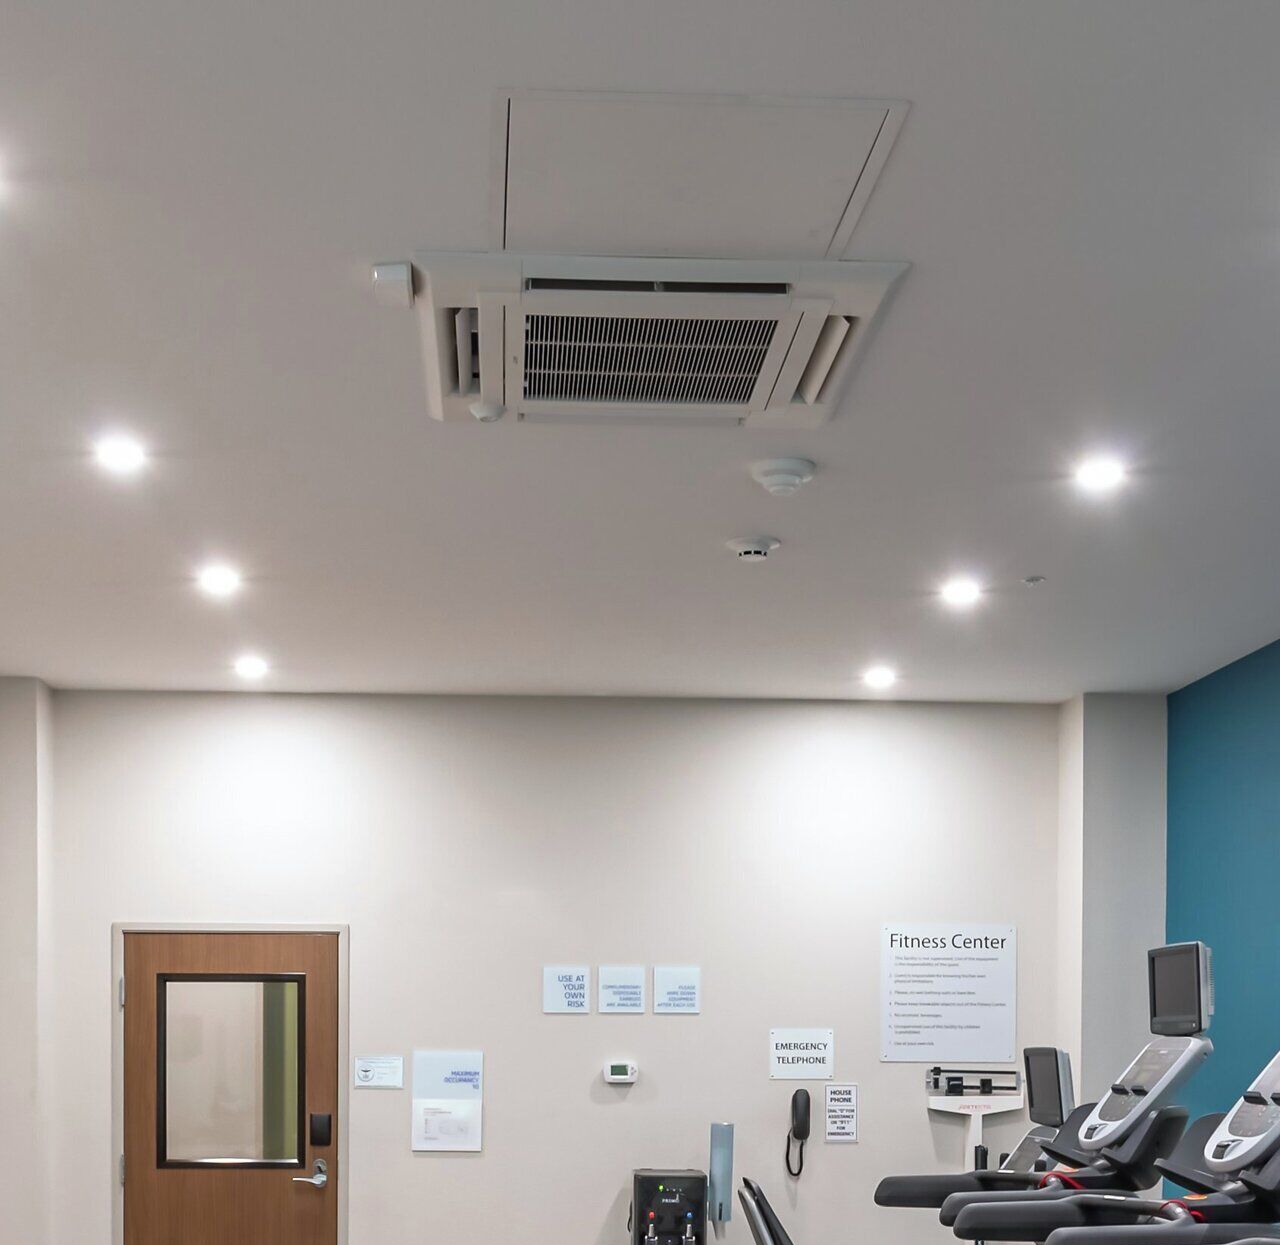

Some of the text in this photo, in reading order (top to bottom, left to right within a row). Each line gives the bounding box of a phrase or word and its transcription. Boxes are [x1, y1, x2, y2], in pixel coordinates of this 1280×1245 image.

[890, 933, 1007, 949] Fitness Center
[557, 975, 584, 983] USE AT
[567, 1000, 585, 1008] RISK
[775, 1042, 828, 1051] EMERGENCY
[776, 1056, 827, 1065] TELEPHONE
